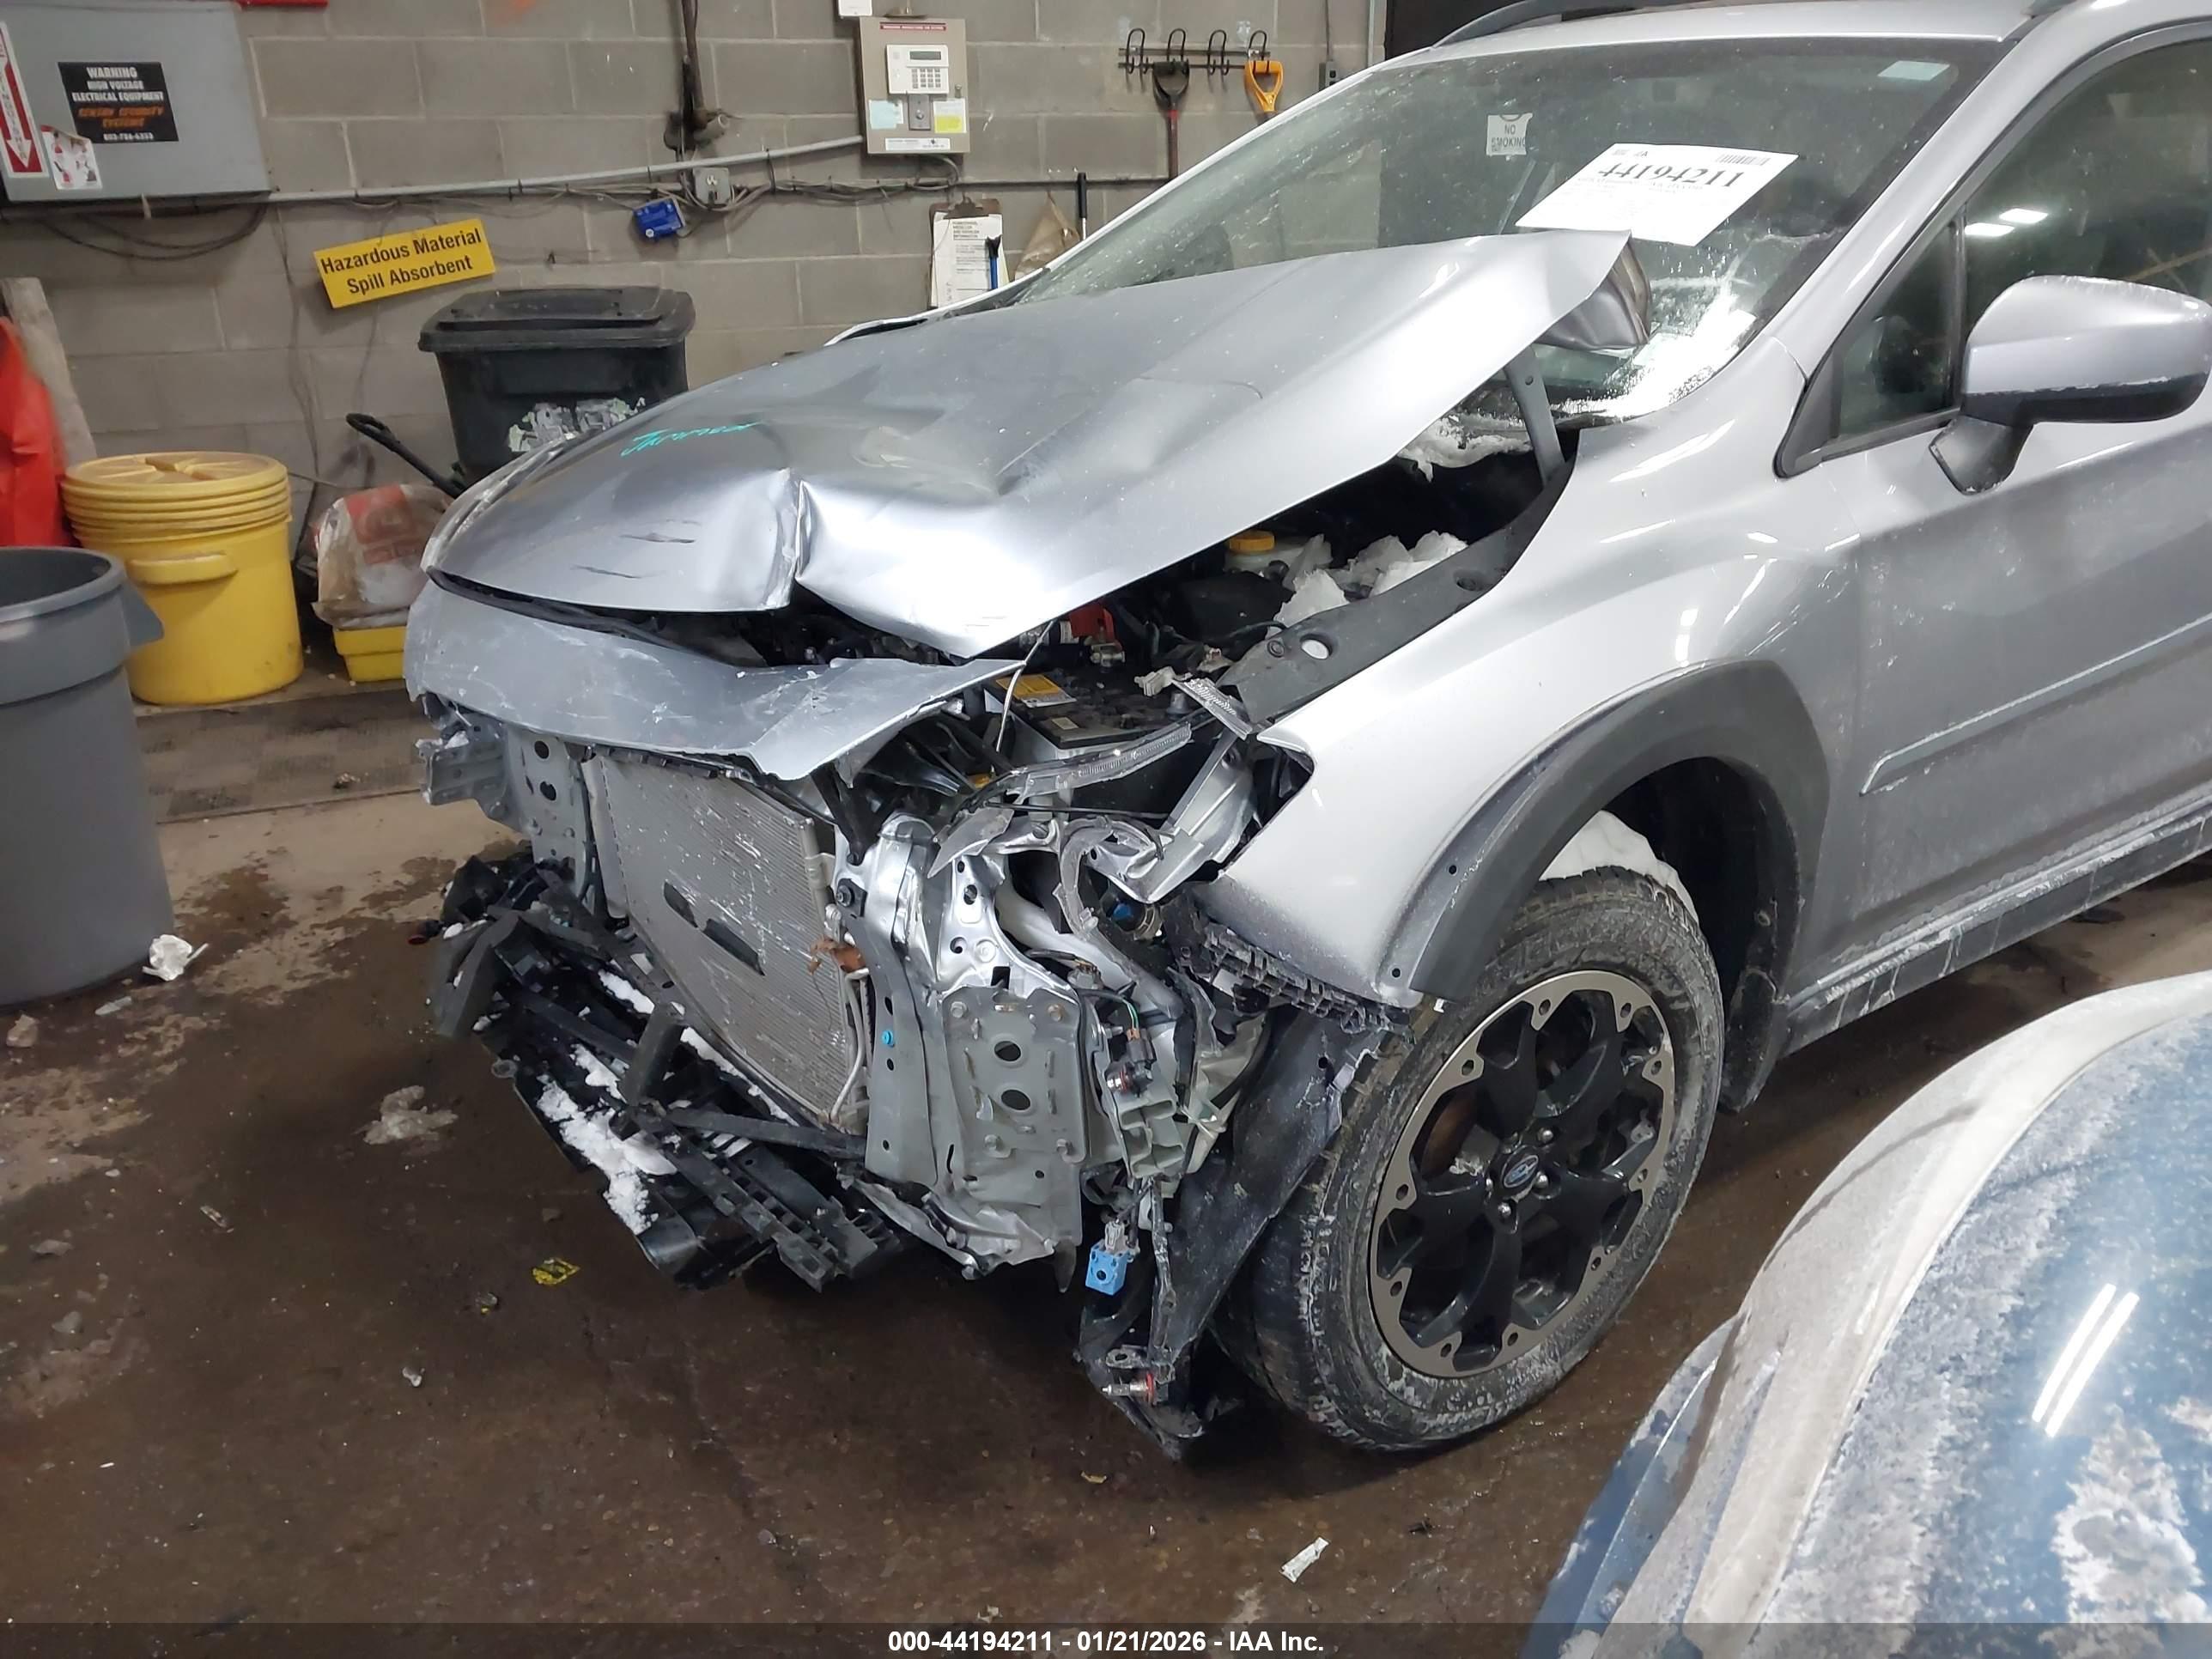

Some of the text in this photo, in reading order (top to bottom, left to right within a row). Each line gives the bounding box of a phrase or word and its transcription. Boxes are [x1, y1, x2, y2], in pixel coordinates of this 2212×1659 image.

[87, 66, 137, 79] WARNING
[108, 80, 144, 90] VOLTAGE
[72, 90, 164, 102] ELECTRICAL EQUIPMENT
[1504, 123, 1516, 135] NO
[1598, 162, 1745, 188] 44194211
[320, 228, 482, 274] Hazardous Material
[347, 255, 473, 295] Spill Absorbent
